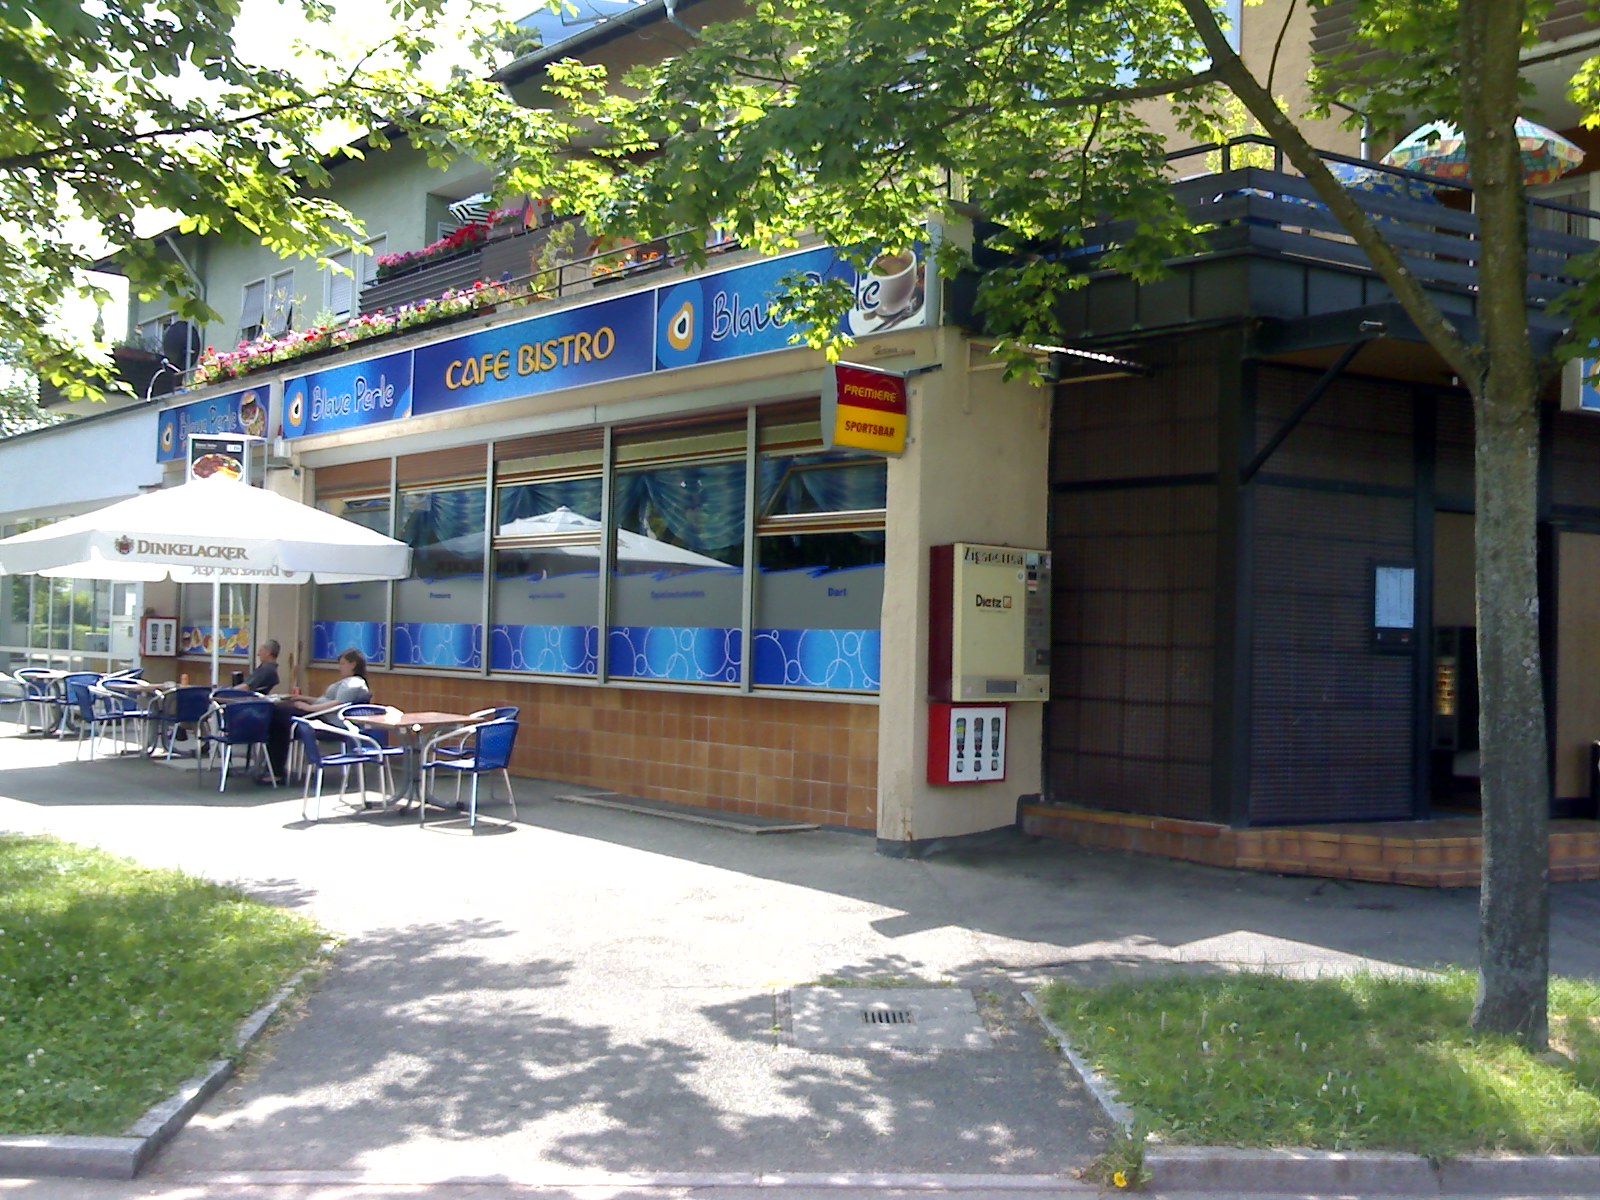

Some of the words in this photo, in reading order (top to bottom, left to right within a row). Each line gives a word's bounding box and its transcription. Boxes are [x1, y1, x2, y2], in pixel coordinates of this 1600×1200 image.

[444, 349, 511, 390] CAFE
[516, 325, 616, 377] BISTRO
[311, 385, 351, 422] Blaue
[353, 375, 395, 413] Perle
[843, 383, 898, 403] PREMIERE
[844, 420, 896, 437] SPORTSBAR
[136, 539, 249, 561] DINKELACKER
[975, 593, 1002, 608] Dietz
